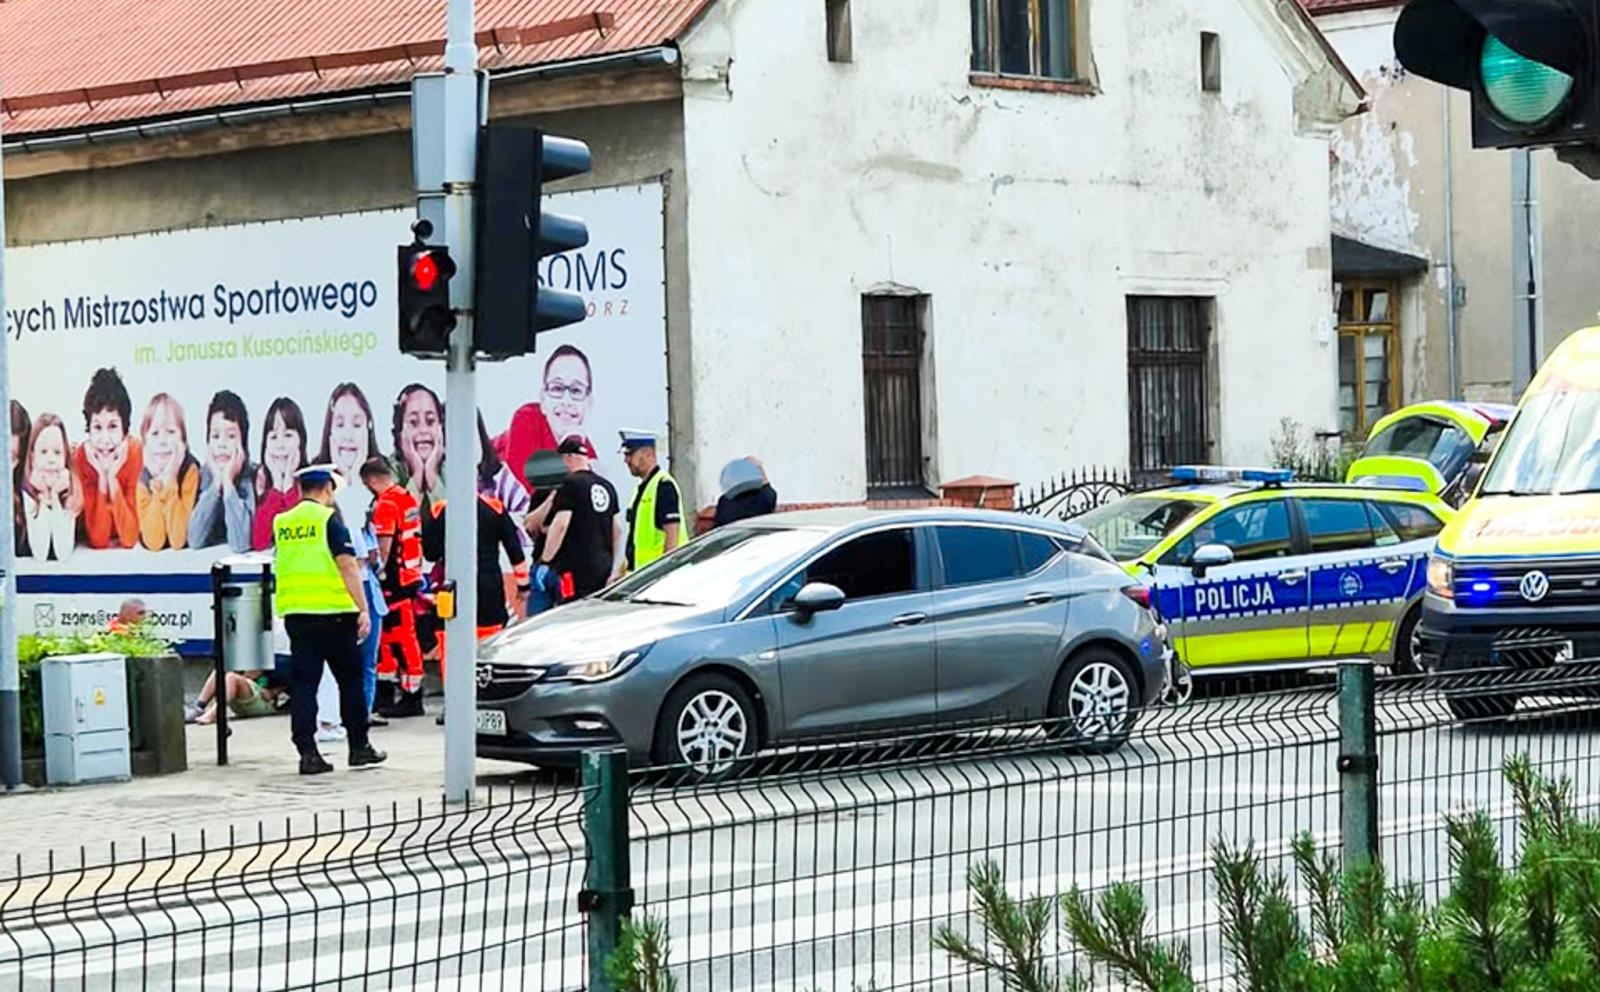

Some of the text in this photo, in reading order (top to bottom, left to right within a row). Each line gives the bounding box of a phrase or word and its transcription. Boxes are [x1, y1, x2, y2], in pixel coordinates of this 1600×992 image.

[64, 289, 206, 330] Mistrzostwa
[213, 279, 378, 323] Sportowego
[133, 330, 378, 364] im. Janusza Kusocińskiego
[278, 524, 317, 541] POLICJA
[1195, 582, 1275, 612] POLICJA
